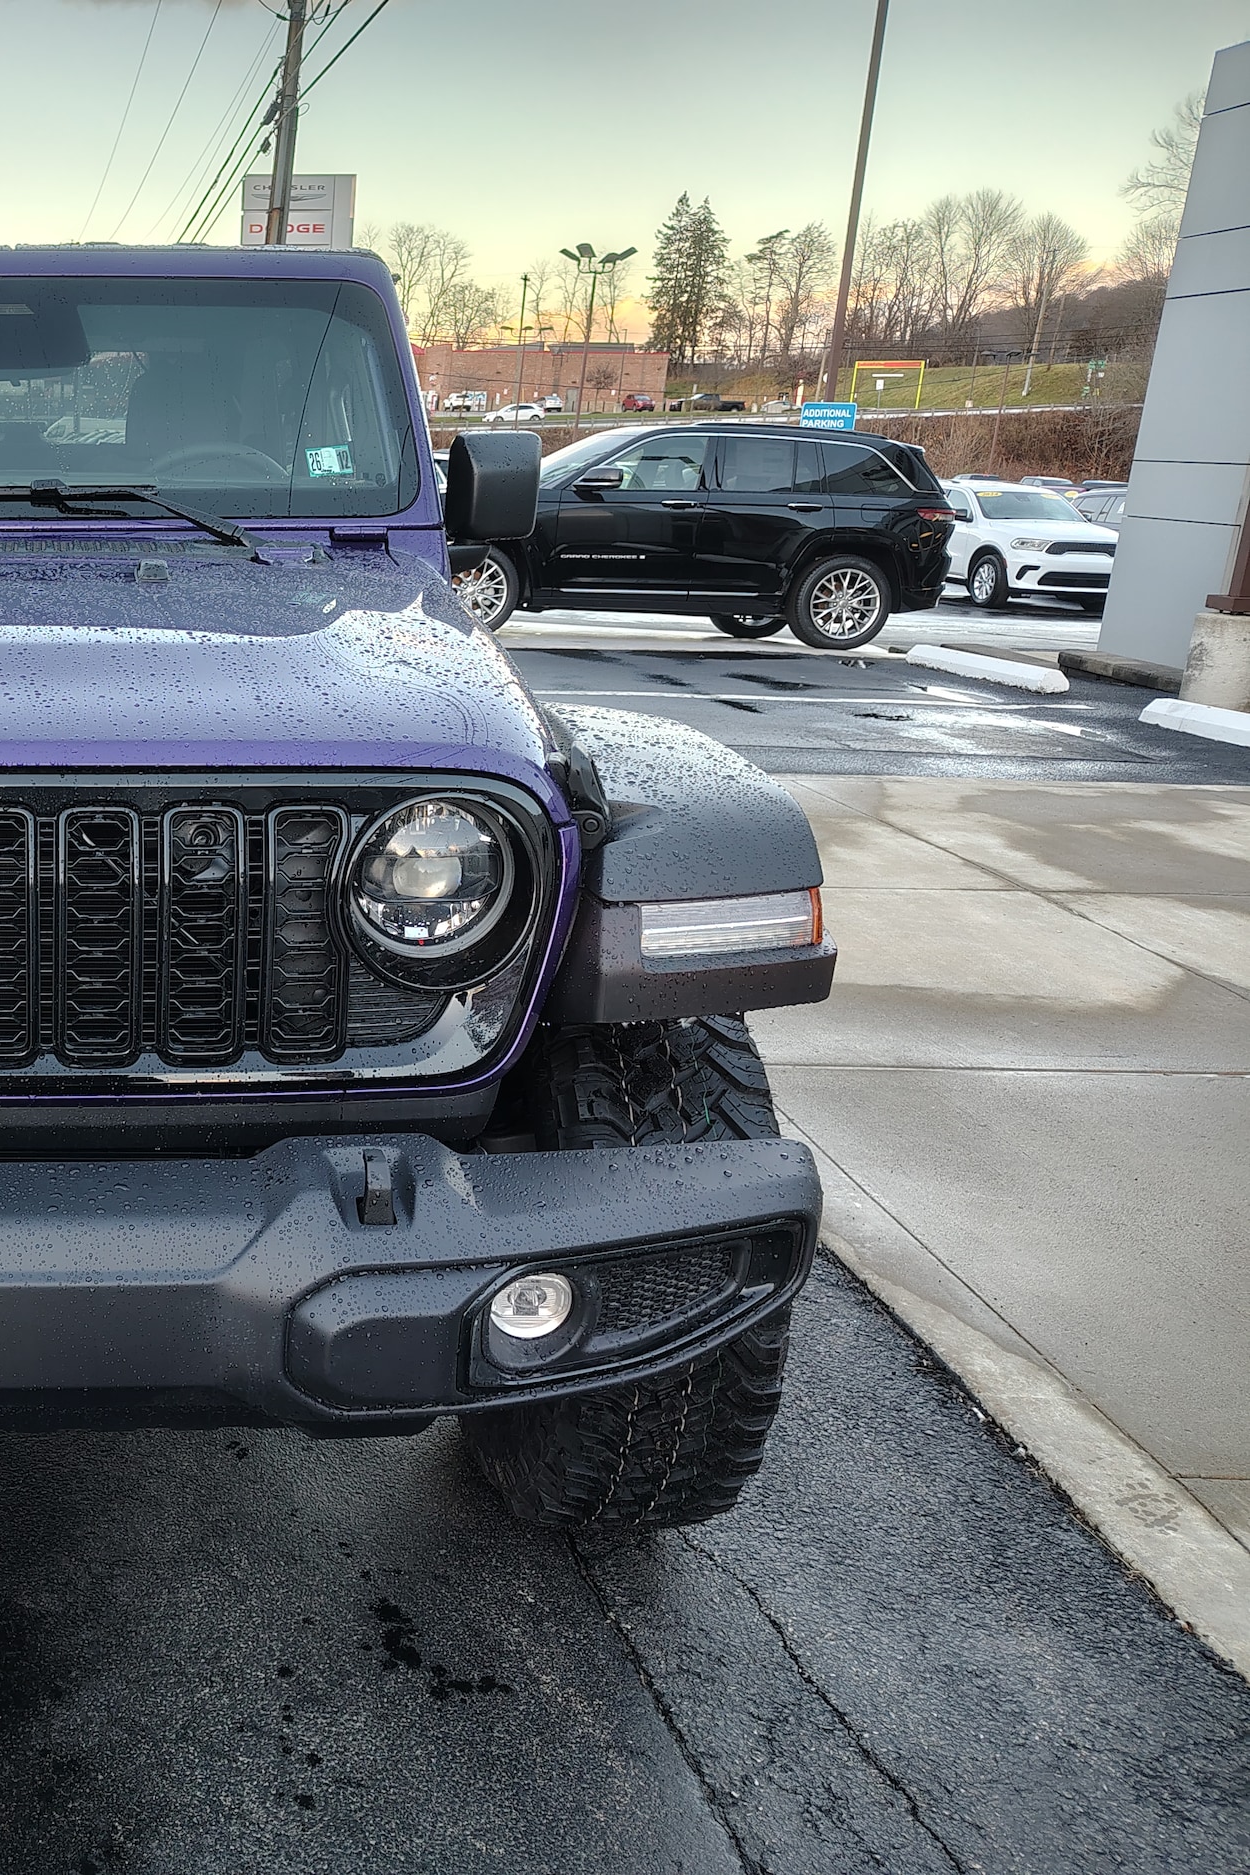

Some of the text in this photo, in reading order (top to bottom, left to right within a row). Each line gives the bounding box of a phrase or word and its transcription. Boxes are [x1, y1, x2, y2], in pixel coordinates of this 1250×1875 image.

[249, 224, 325, 233] DDGE
[803, 409, 851, 417] ADDITIONAL
[802, 419, 844, 428] PARKING
[309, 451, 351, 471] 26 12
